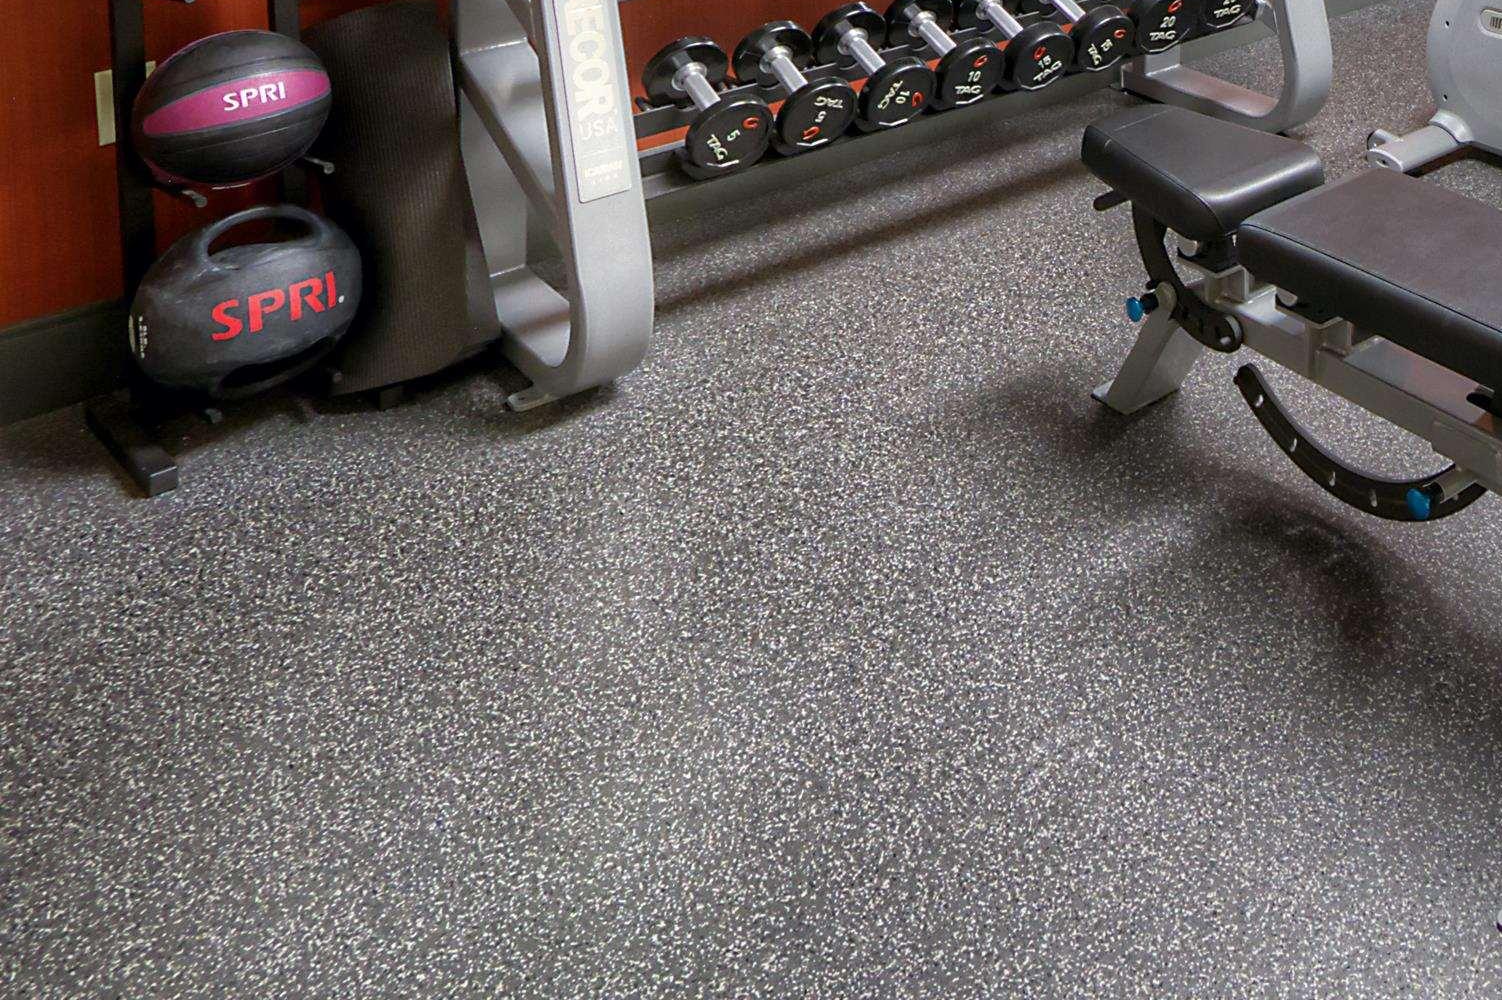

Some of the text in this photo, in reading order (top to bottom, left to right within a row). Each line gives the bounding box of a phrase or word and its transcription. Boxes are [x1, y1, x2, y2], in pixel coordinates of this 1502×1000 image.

[1213, 4, 1242, 19] TAG
[1162, 15, 1177, 28] 20
[1149, 30, 1177, 41] TAG
[967, 70, 982, 83] 10
[222, 81, 287, 112] SPRI
[896, 90, 911, 105] 10
[955, 85, 983, 96] TAG
[814, 95, 846, 109] TAG
[814, 110, 827, 124] 5
[578, 117, 619, 140] USA
[726, 129, 741, 142] 5
[706, 133, 729, 161] TAG
